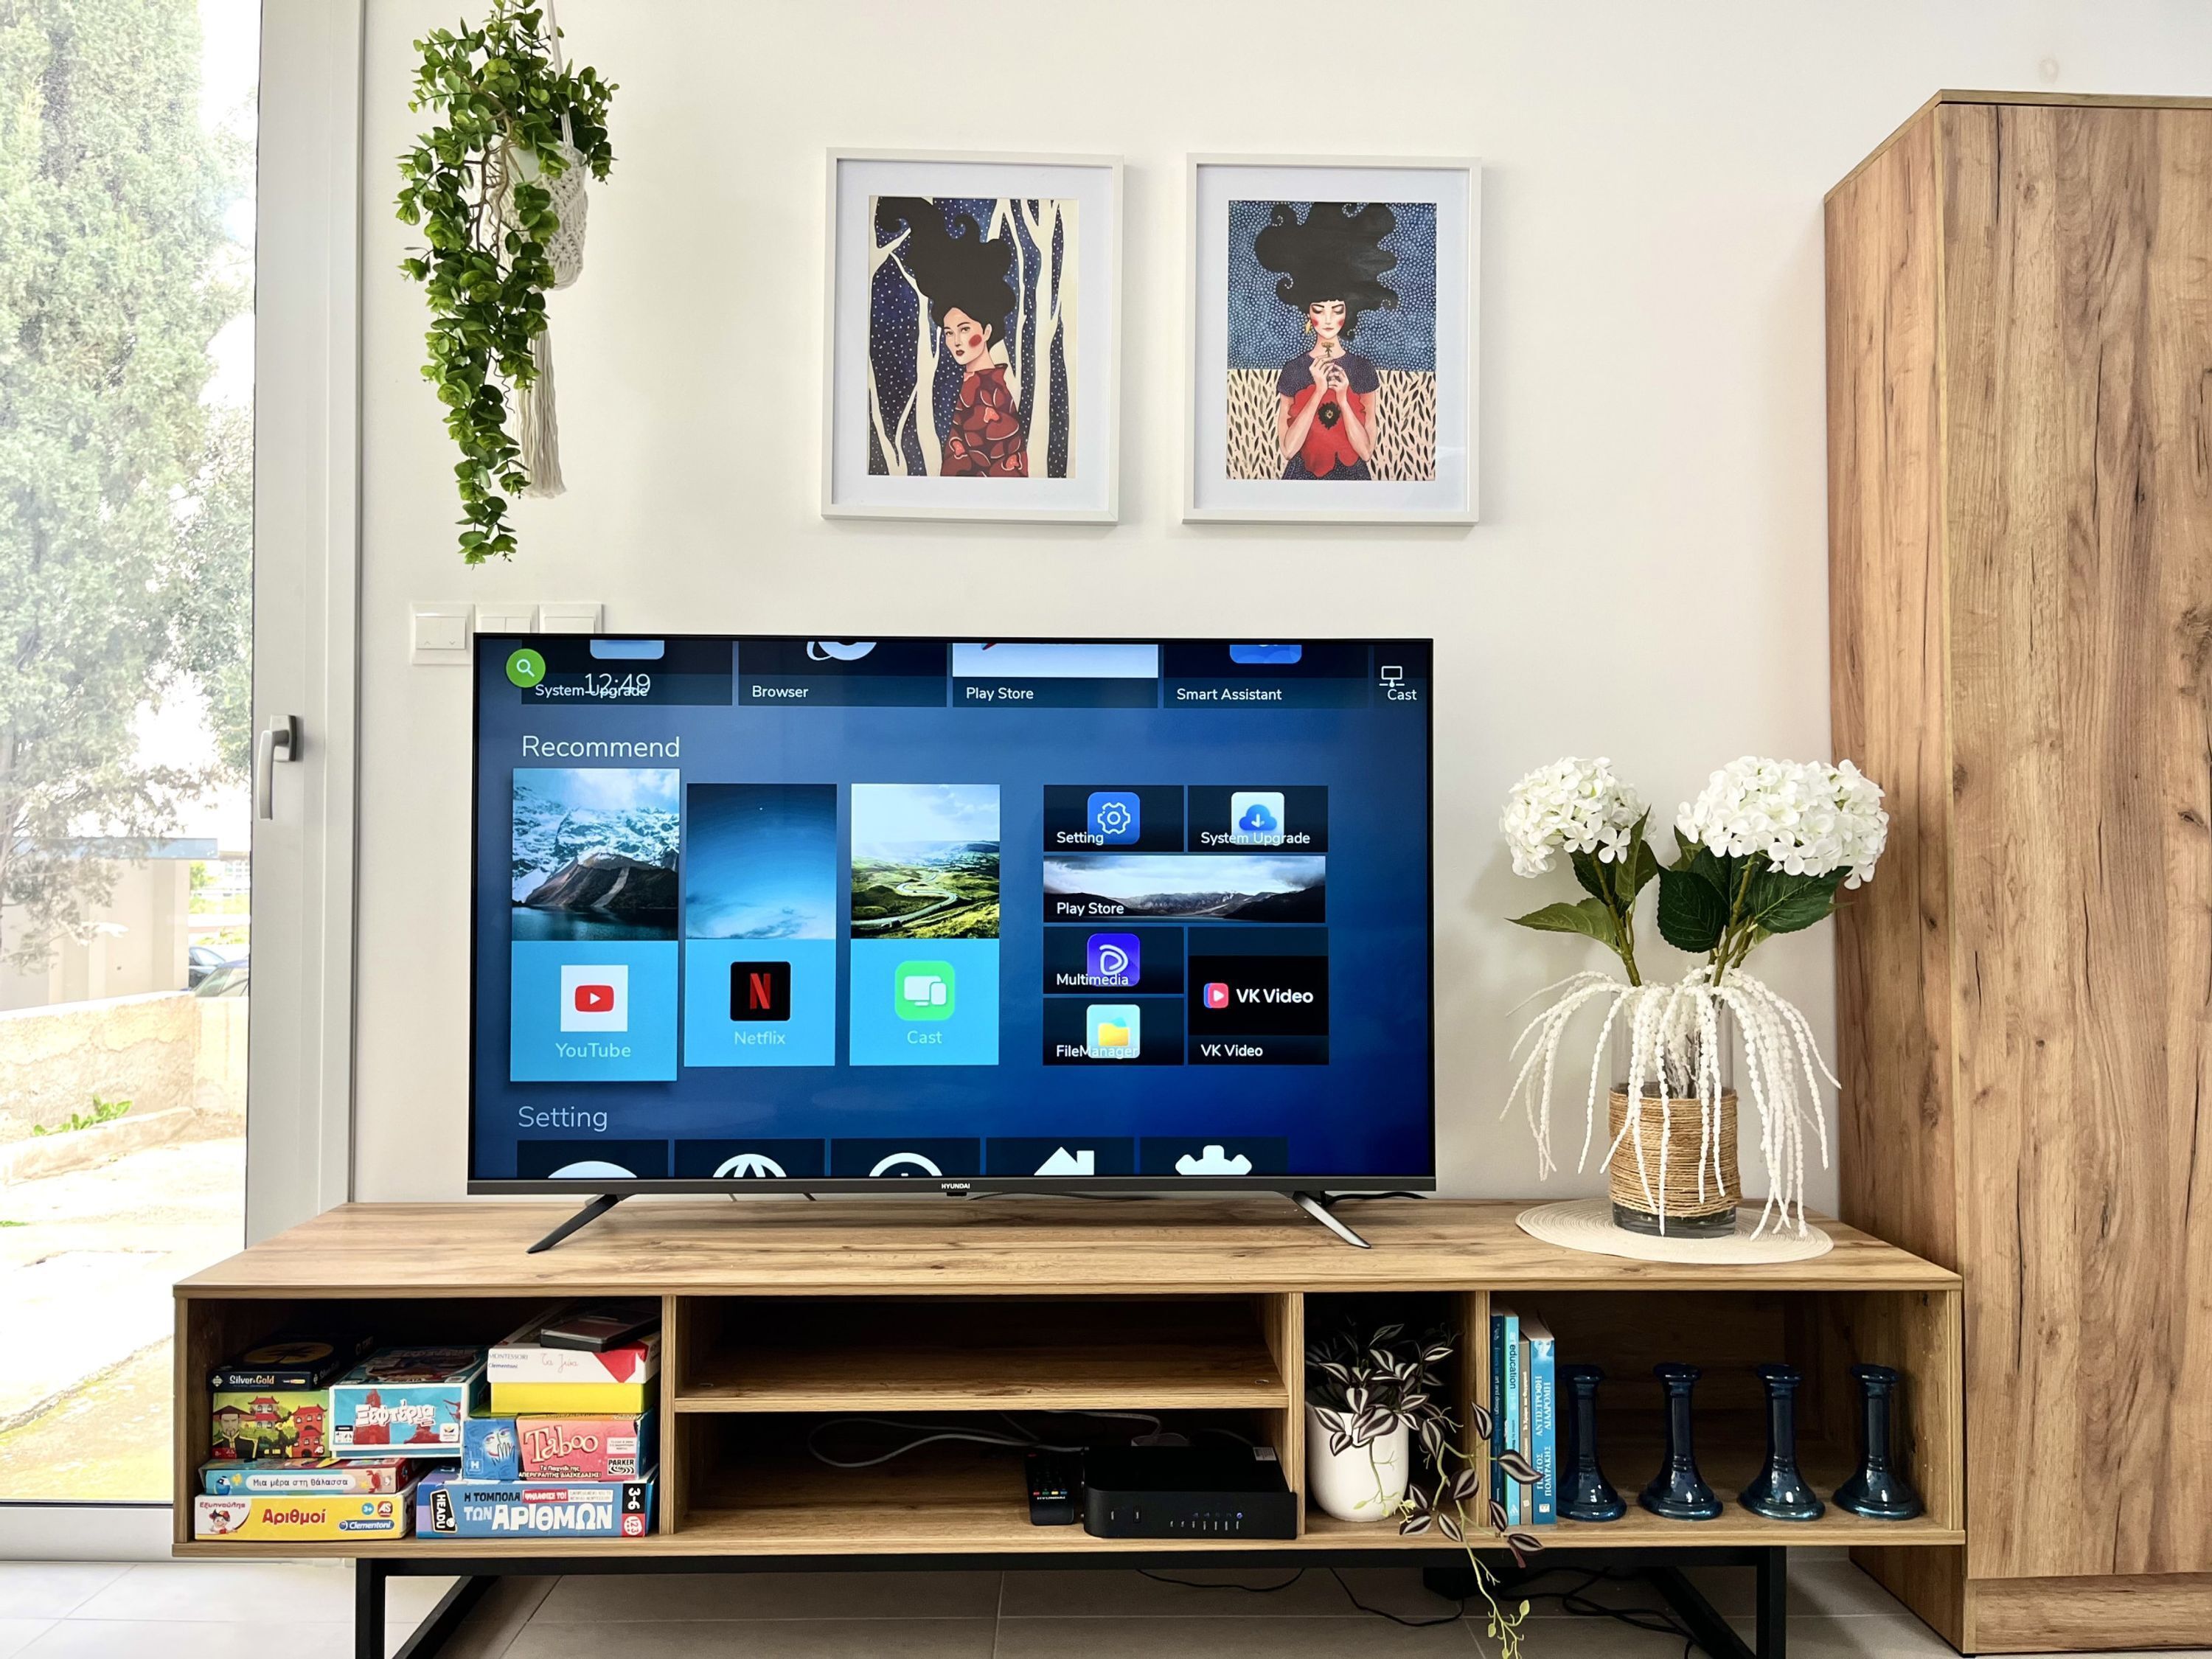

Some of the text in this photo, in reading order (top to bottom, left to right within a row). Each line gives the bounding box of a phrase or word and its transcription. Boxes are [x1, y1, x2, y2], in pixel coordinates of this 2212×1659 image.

[535, 684, 647, 698] System Upgrade
[585, 673, 650, 694] 12:49
[751, 685, 809, 699] Browser
[966, 686, 1034, 701] Play Store
[1176, 688, 1282, 700] Smart Assistant
[1387, 688, 1418, 701] Cast
[521, 735, 681, 759] Recommend
[1056, 831, 1105, 846] Setting
[1200, 831, 1311, 846] System Upgrade
[1056, 902, 1124, 917] Play Store
[1056, 973, 1129, 986] Multimedia
[1236, 988, 1314, 1004] VK Video
[734, 1030, 786, 1046] Netflix
[906, 1030, 943, 1045] Cast
[555, 1043, 632, 1059] YouTube
[1056, 1044, 1139, 1059] FileManager
[1200, 1044, 1264, 1057] VK Video
[518, 1105, 608, 1133] Setting
[489, 1353, 529, 1361] MONTESSORI
[1509, 1344, 1517, 1389] education
[355, 1398, 436, 1427] Ξεφτέρια
[524, 1425, 599, 1464] Taboo
[270, 1478, 291, 1488] μέρα
[293, 1480, 308, 1488] στη
[310, 1478, 349, 1486] θάλασσα
[474, 1492, 521, 1502] ΤΟΜΠΟΛΑ
[627, 1487, 641, 1510] 3-6
[378, 1503, 392, 1513] AS
[436, 1494, 446, 1528] HEADU
[262, 1508, 326, 1525] Αριθμοί
[464, 1503, 613, 1531] ΤΩΝ ΑΡΙΘΜΩΝ
[349, 1521, 392, 1530] Clementoni
